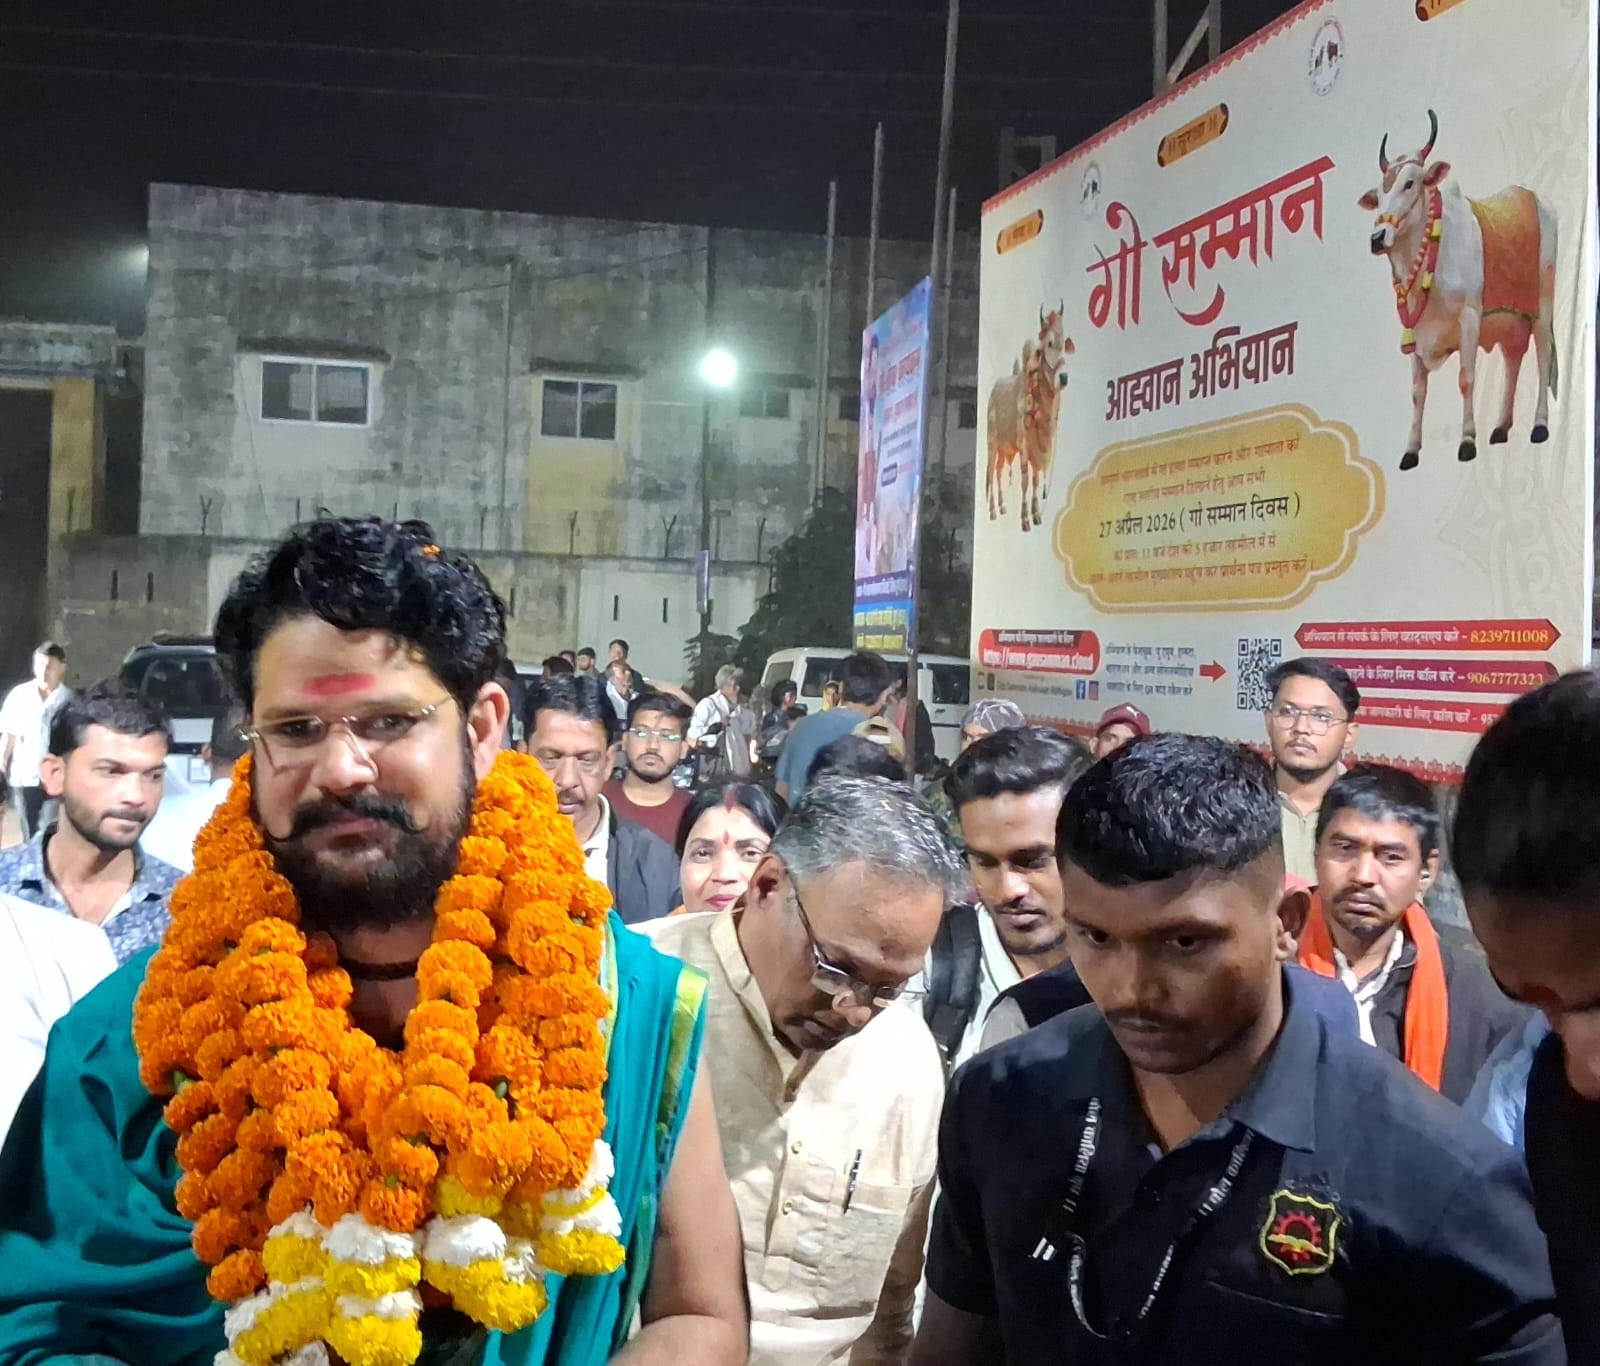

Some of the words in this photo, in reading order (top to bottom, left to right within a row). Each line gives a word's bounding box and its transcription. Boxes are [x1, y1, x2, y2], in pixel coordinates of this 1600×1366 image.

[1152, 155, 1336, 327] सम्मान
[1189, 321, 1299, 400] अभियान
[1099, 520, 1112, 538] 27
[1146, 511, 1177, 533] 2026
[1179, 507, 1186, 532] (
[1206, 502, 1248, 527] सम्मान
[1250, 492, 1289, 520] दिवस
[1293, 490, 1301, 519] )
[1470, 629, 1549, 644] 8239711008
[1376, 665, 1395, 684] लिए
[1395, 665, 1415, 681] मिस
[1416, 667, 1437, 682] कॉल
[1467, 671, 1544, 686] 9067777323
